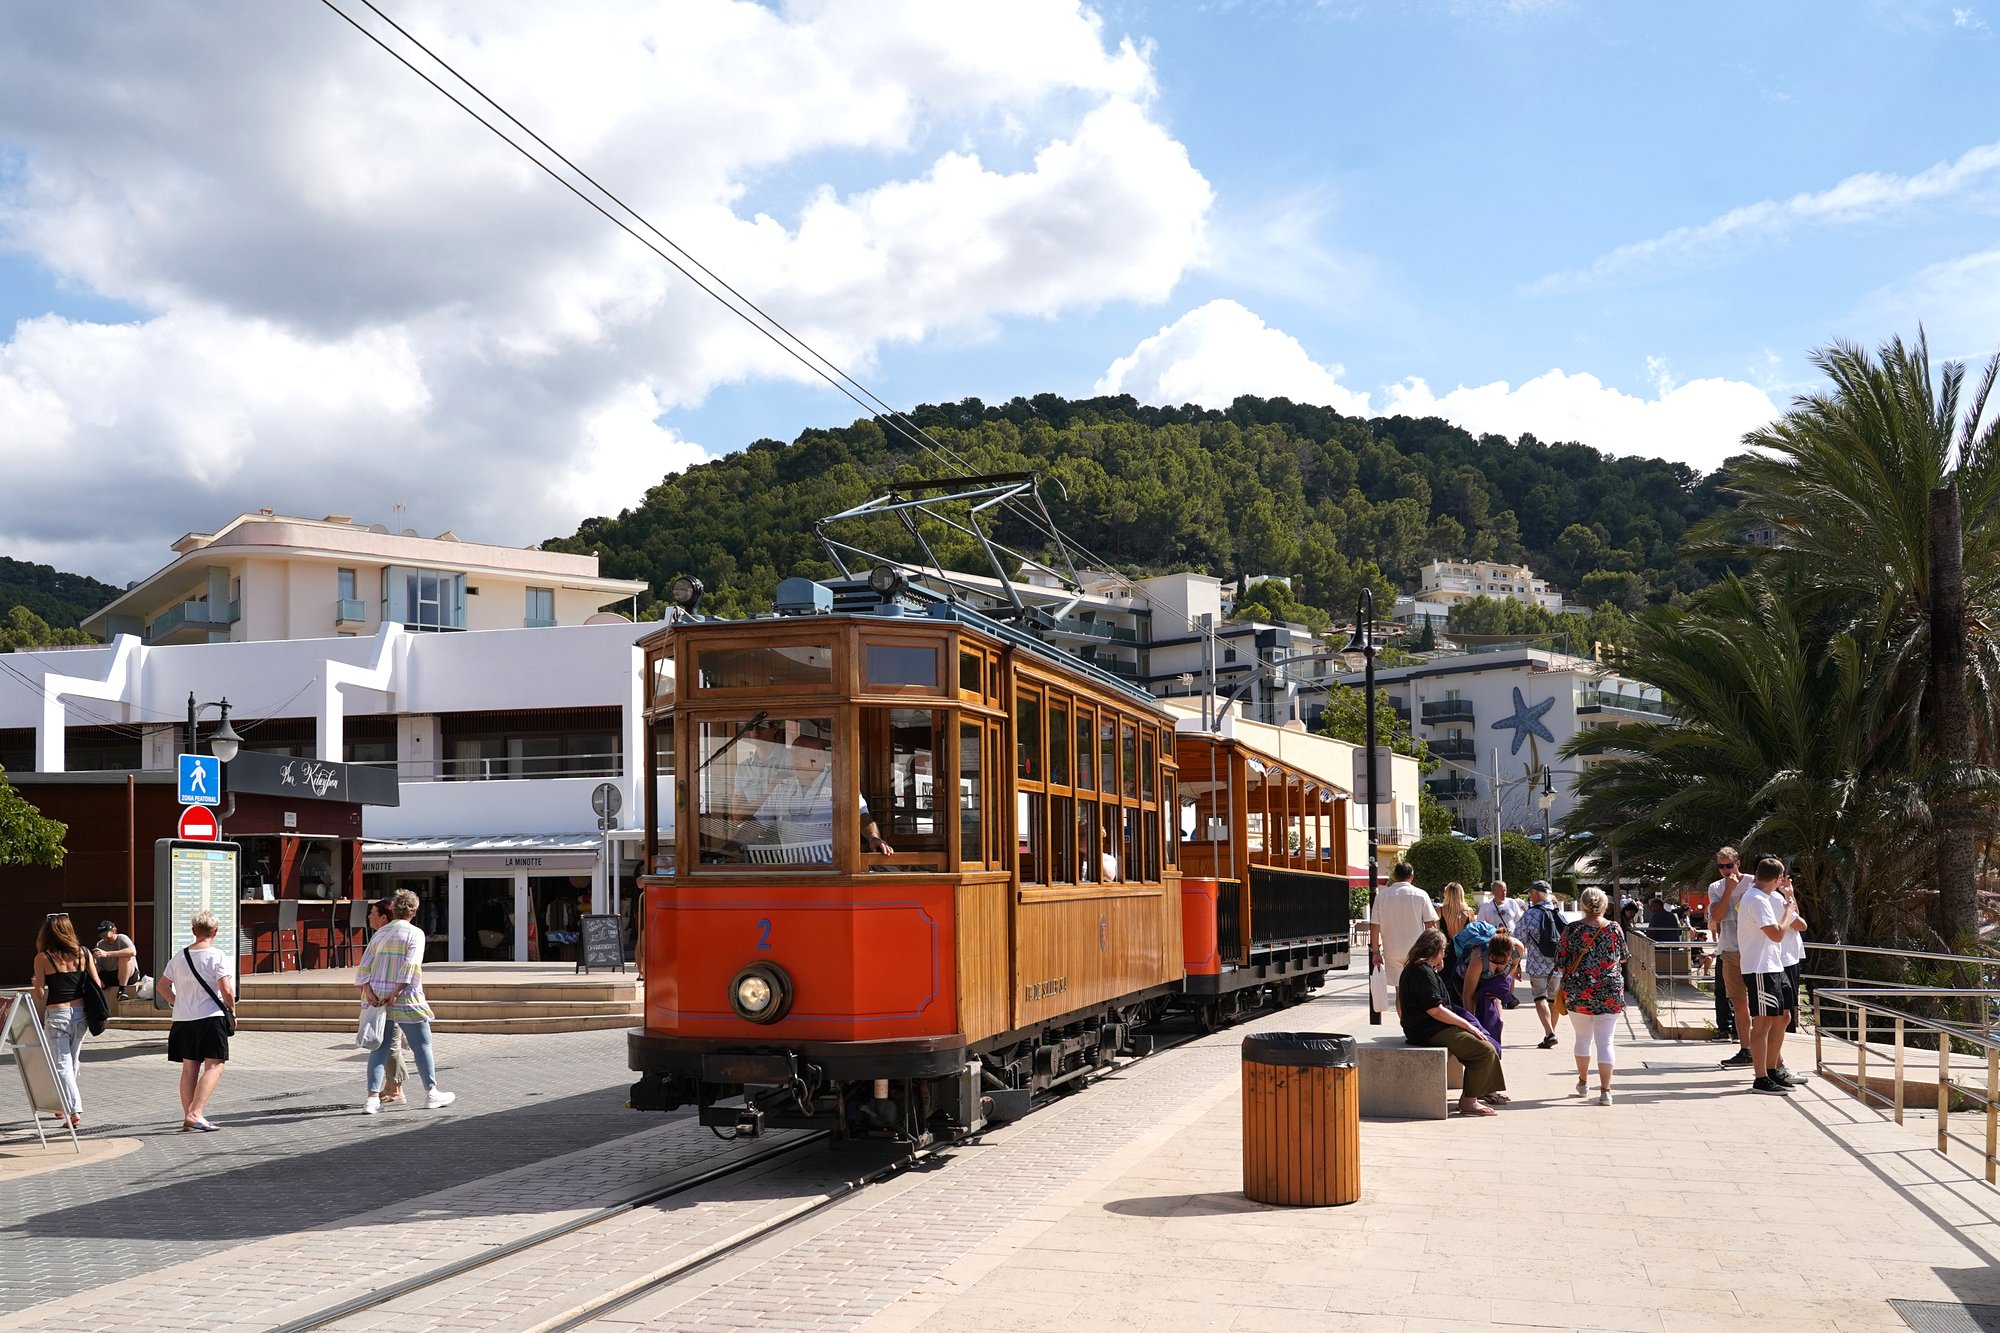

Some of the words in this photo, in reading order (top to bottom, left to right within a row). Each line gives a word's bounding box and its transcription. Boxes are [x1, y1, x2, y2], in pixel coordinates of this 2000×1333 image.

[181, 794, 194, 802] ZONA
[194, 795, 217, 803] PEATONAL
[505, 858, 513, 866] LA
[514, 857, 542, 866] MINOTTE
[362, 862, 392, 871] MINOTTE
[757, 918, 771, 950] 2
